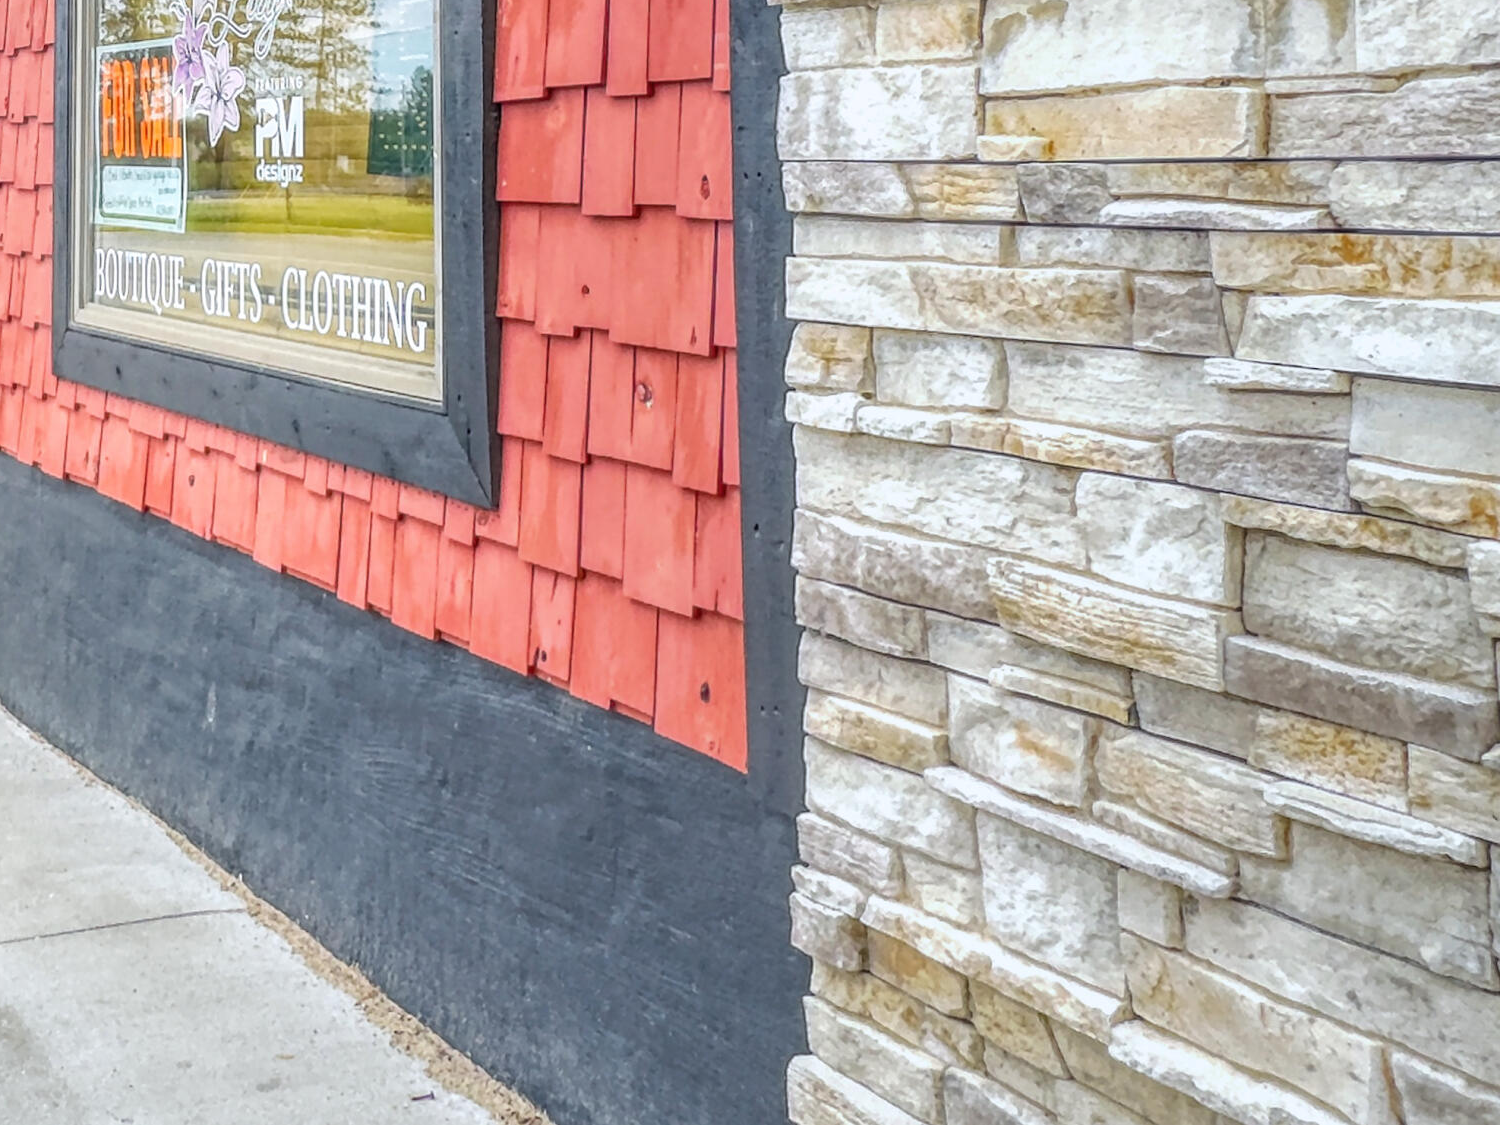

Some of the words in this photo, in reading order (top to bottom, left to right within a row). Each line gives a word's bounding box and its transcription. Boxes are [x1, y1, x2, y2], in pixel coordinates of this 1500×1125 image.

[101, 59, 136, 159] FOR
[255, 95, 304, 158] PM
[256, 158, 303, 188] designz
[95, 248, 186, 316] BOUTIQUE
[201, 258, 262, 324] GIFTS
[282, 265, 428, 353] CLOTHING
